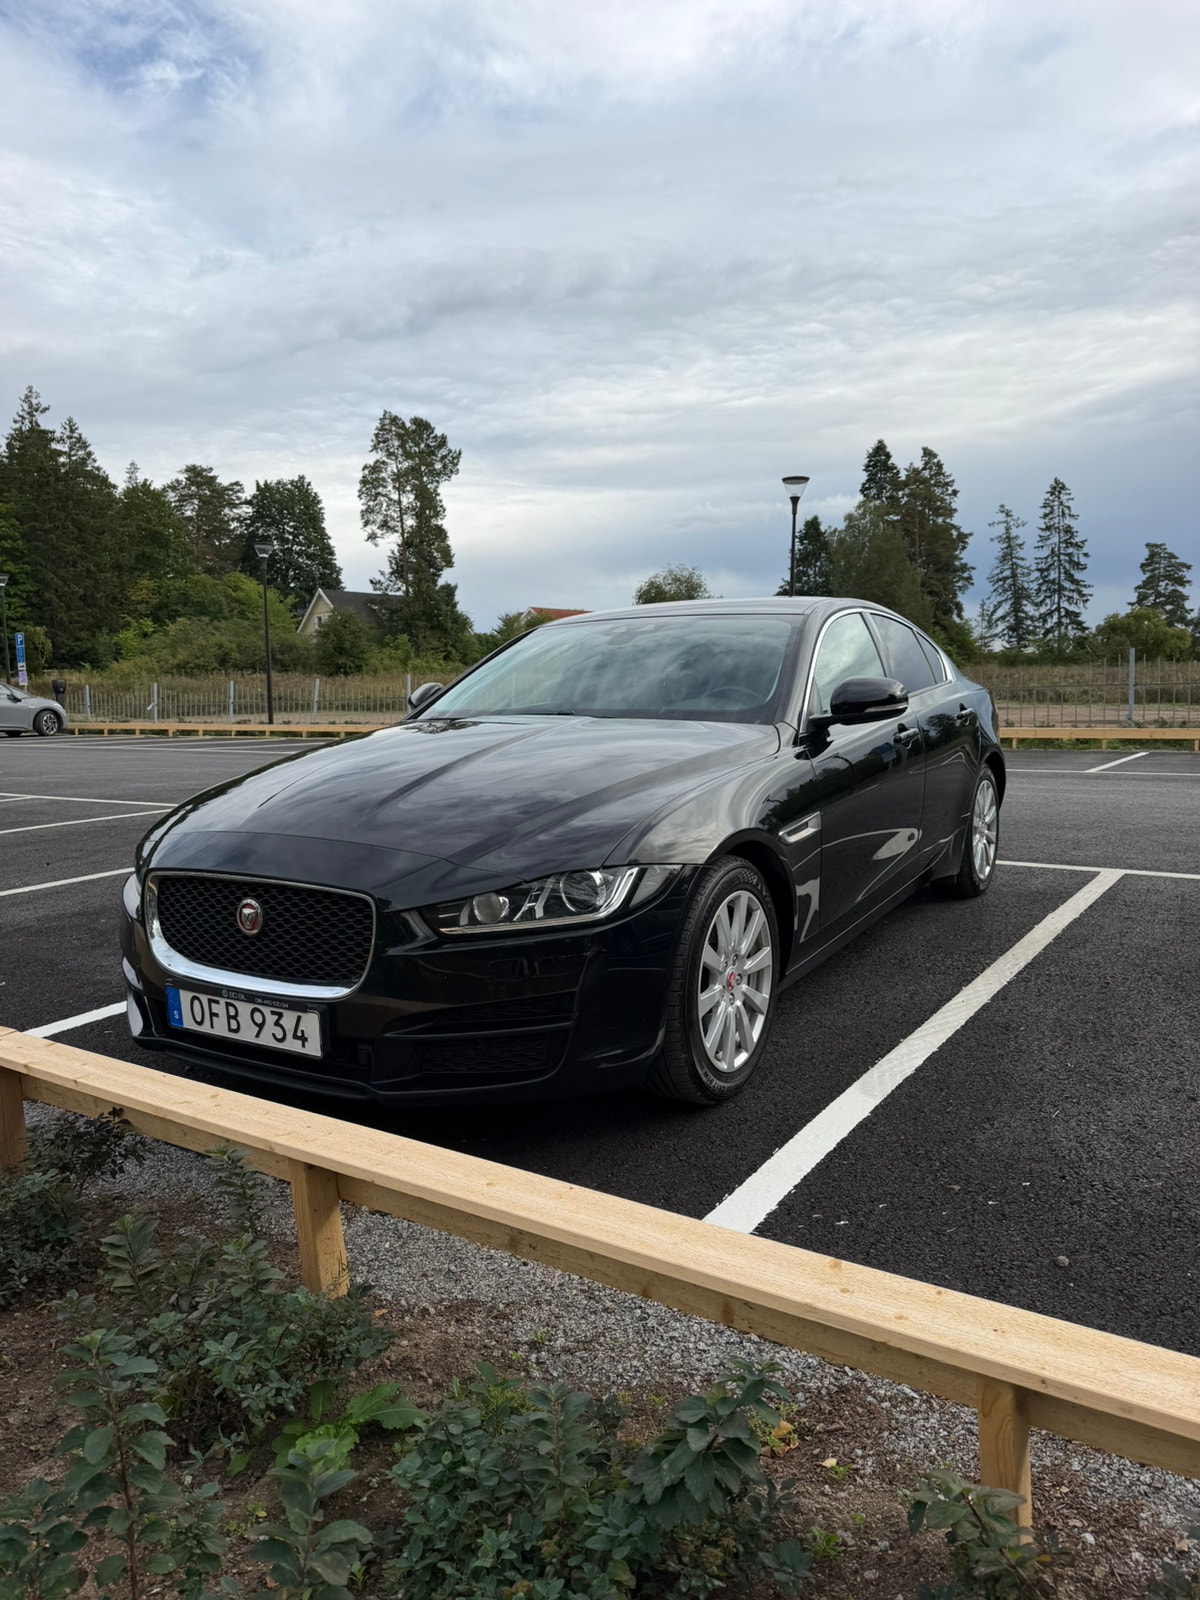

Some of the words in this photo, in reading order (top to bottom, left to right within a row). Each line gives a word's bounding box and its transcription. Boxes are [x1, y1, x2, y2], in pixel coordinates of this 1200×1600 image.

[18, 634, 22, 644] P
[174, 1010, 179, 1019] S
[190, 995, 241, 1034] OFB
[250, 1007, 309, 1048] 934
